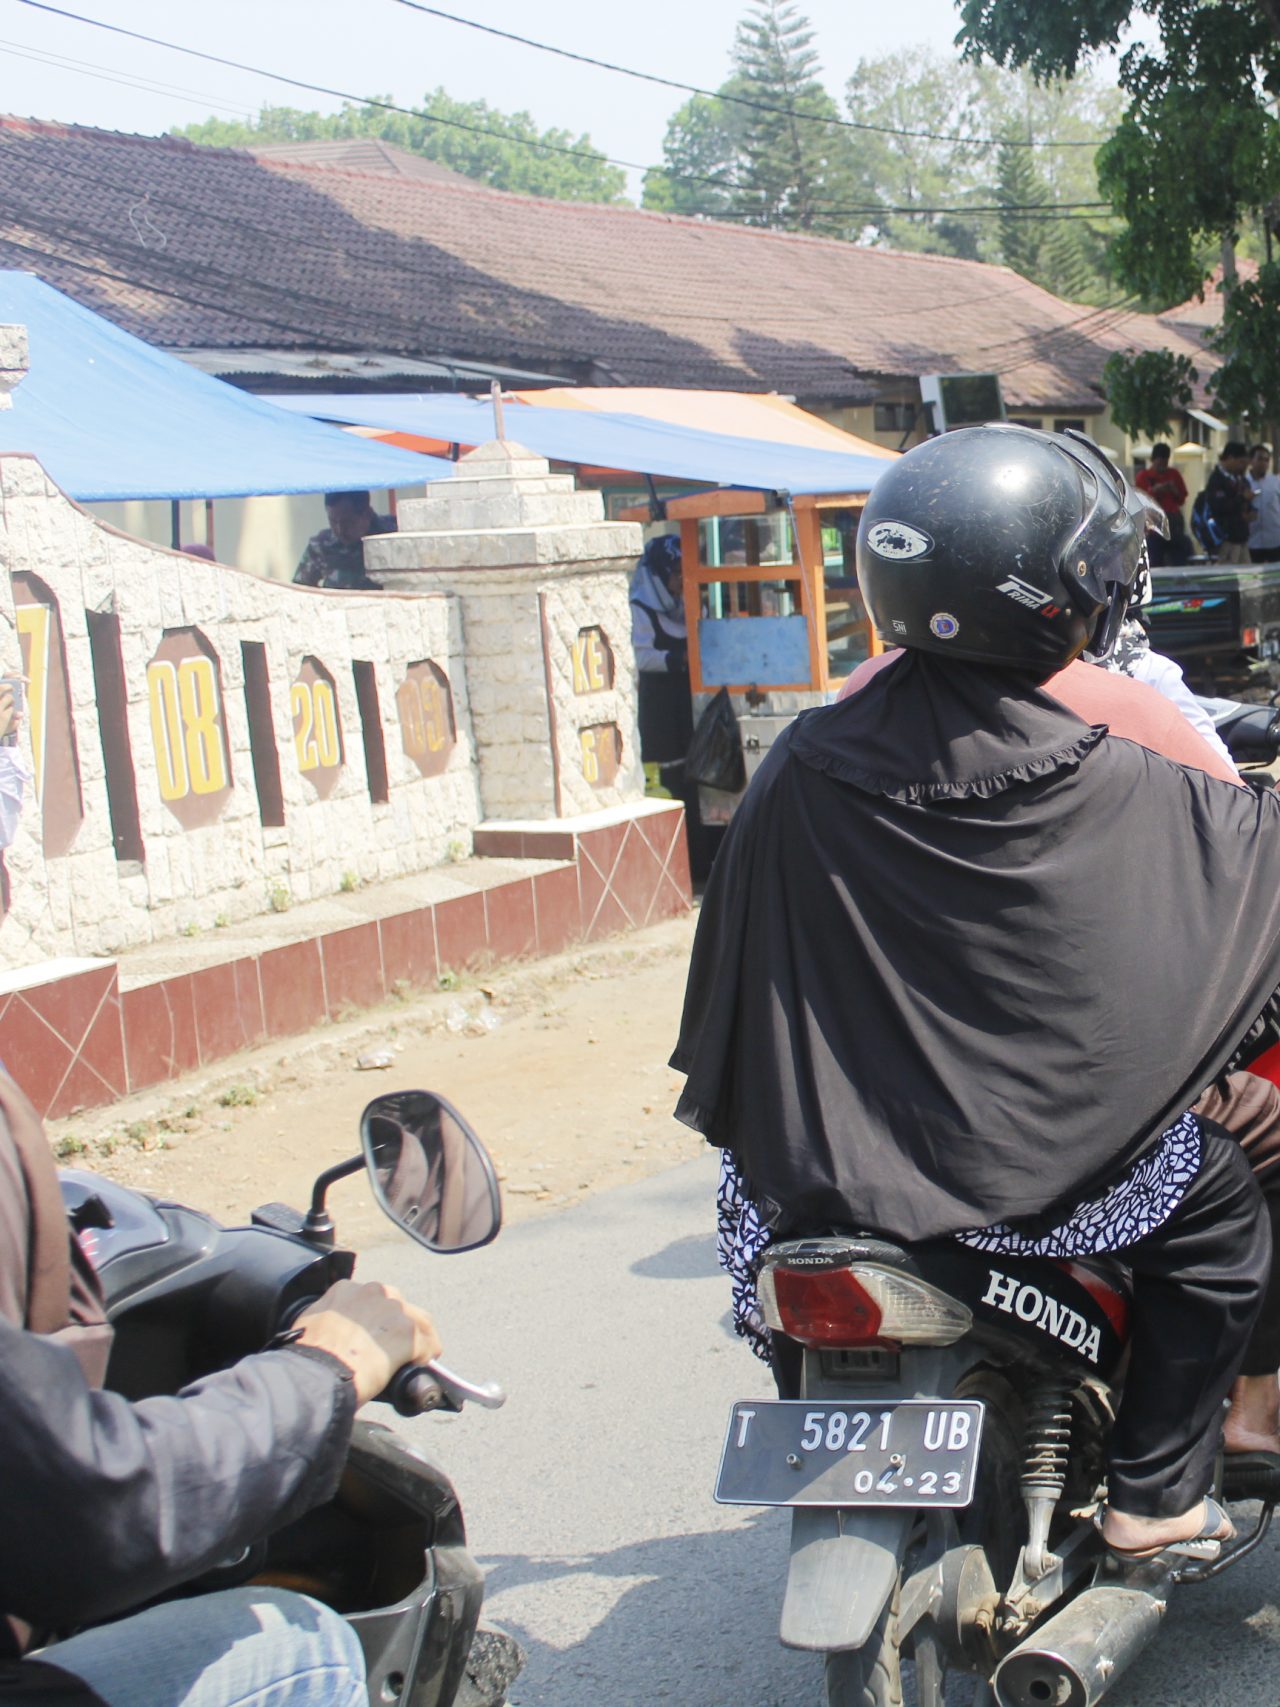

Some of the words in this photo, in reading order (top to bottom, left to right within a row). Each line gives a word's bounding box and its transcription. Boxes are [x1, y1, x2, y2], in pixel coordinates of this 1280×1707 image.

[996, 574, 1054, 610] PRIMA
[572, 629, 604, 695] KE
[147, 655, 227, 800] 08
[290, 679, 341, 772] 20
[787, 1256, 834, 1266] HONDA
[981, 1269, 1101, 1364] HONDA
[736, 1410, 756, 1449] T
[801, 1411, 892, 1452] 5821
[923, 1411, 970, 1452] UB
